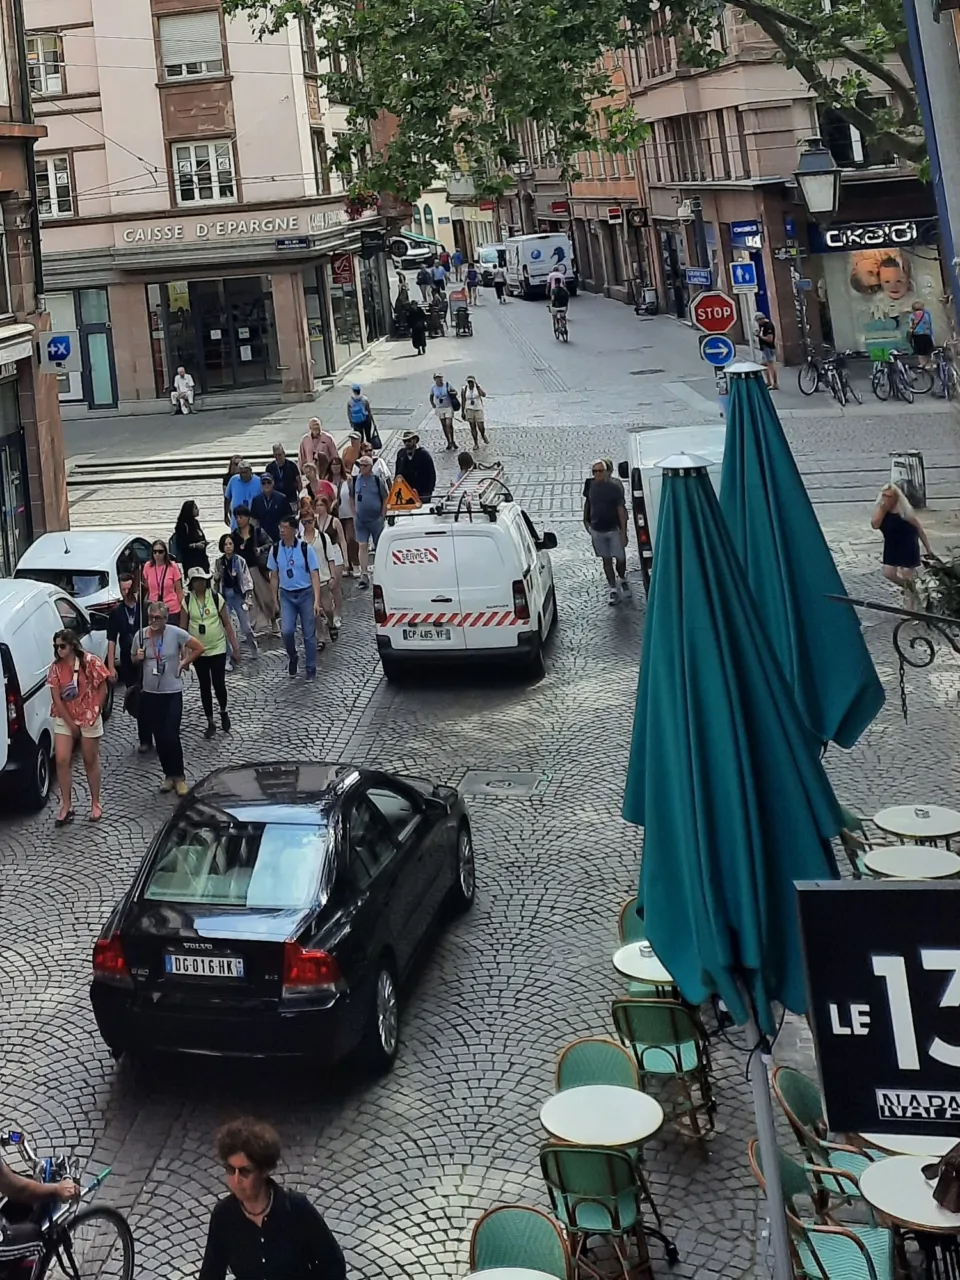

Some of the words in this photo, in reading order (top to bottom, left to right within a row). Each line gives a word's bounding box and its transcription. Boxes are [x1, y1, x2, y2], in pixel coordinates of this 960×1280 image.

[123, 226, 184, 243] CAISSE
[196, 217, 299, 237] D'EPARGNE
[697, 306, 731, 320] STOP
[401, 552, 429, 561] SERVICE
[174, 956, 234, 975] DG-016-HK
[829, 1004, 871, 1035] LE
